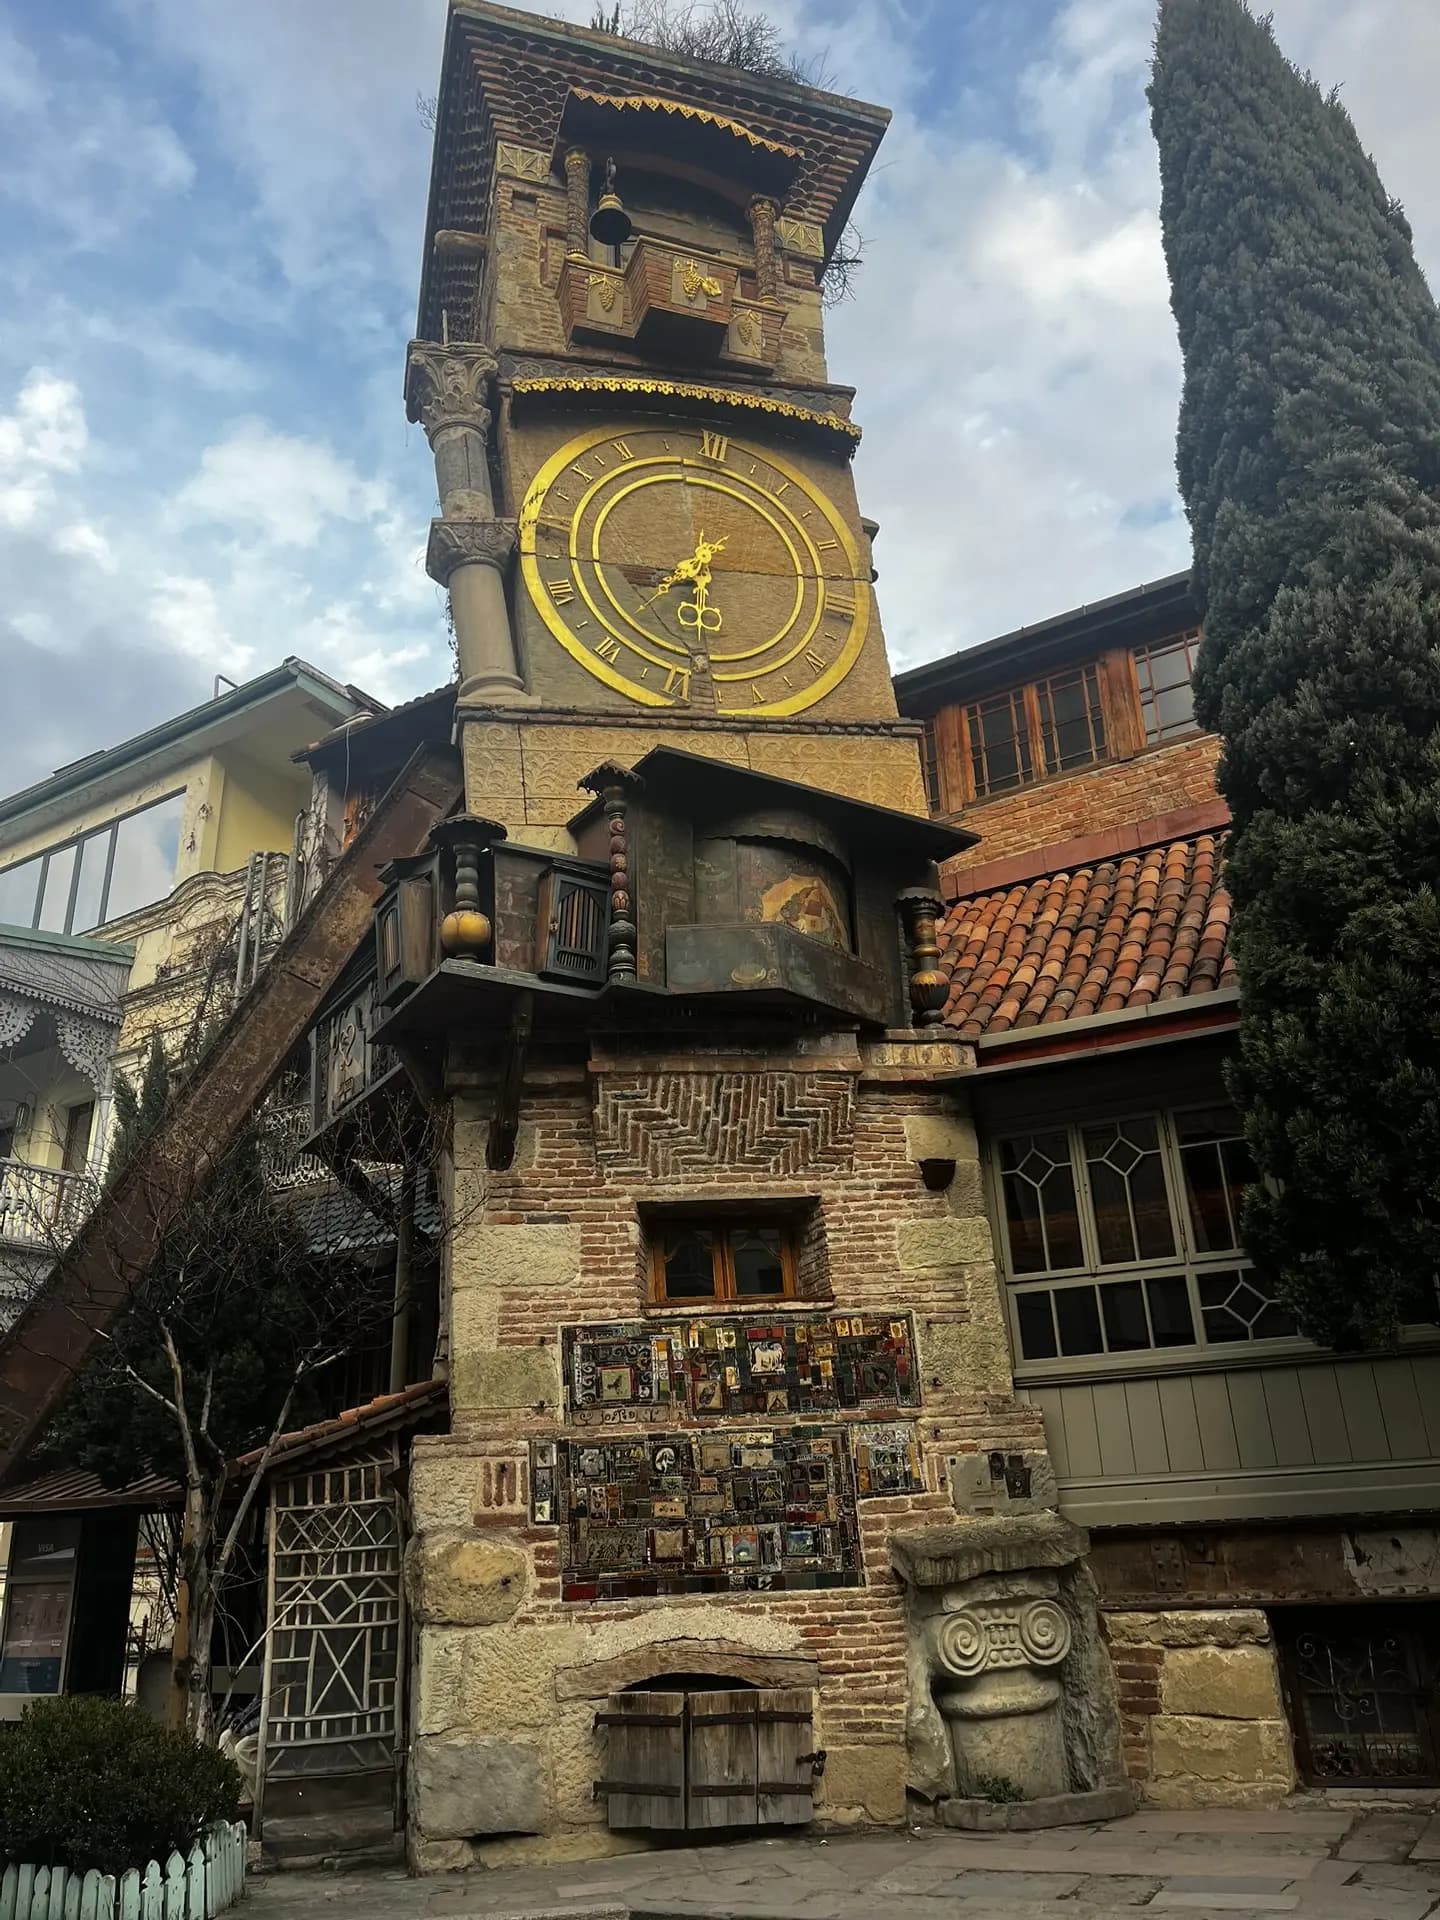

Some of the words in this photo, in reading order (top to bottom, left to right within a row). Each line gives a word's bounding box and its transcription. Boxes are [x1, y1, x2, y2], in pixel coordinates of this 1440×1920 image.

[612, 438, 635, 461] XI
[698, 427, 731, 463] XII
[571, 464, 594, 484] X
[776, 482, 790, 496] I
[817, 539, 838, 552] II
[546, 578, 575, 606] VIII
[825, 591, 856, 615] III
[592, 636, 621, 666] VII
[660, 665, 692, 702] VI
[751, 683, 766, 705] V
[38, 1543, 54, 1553] VISA
